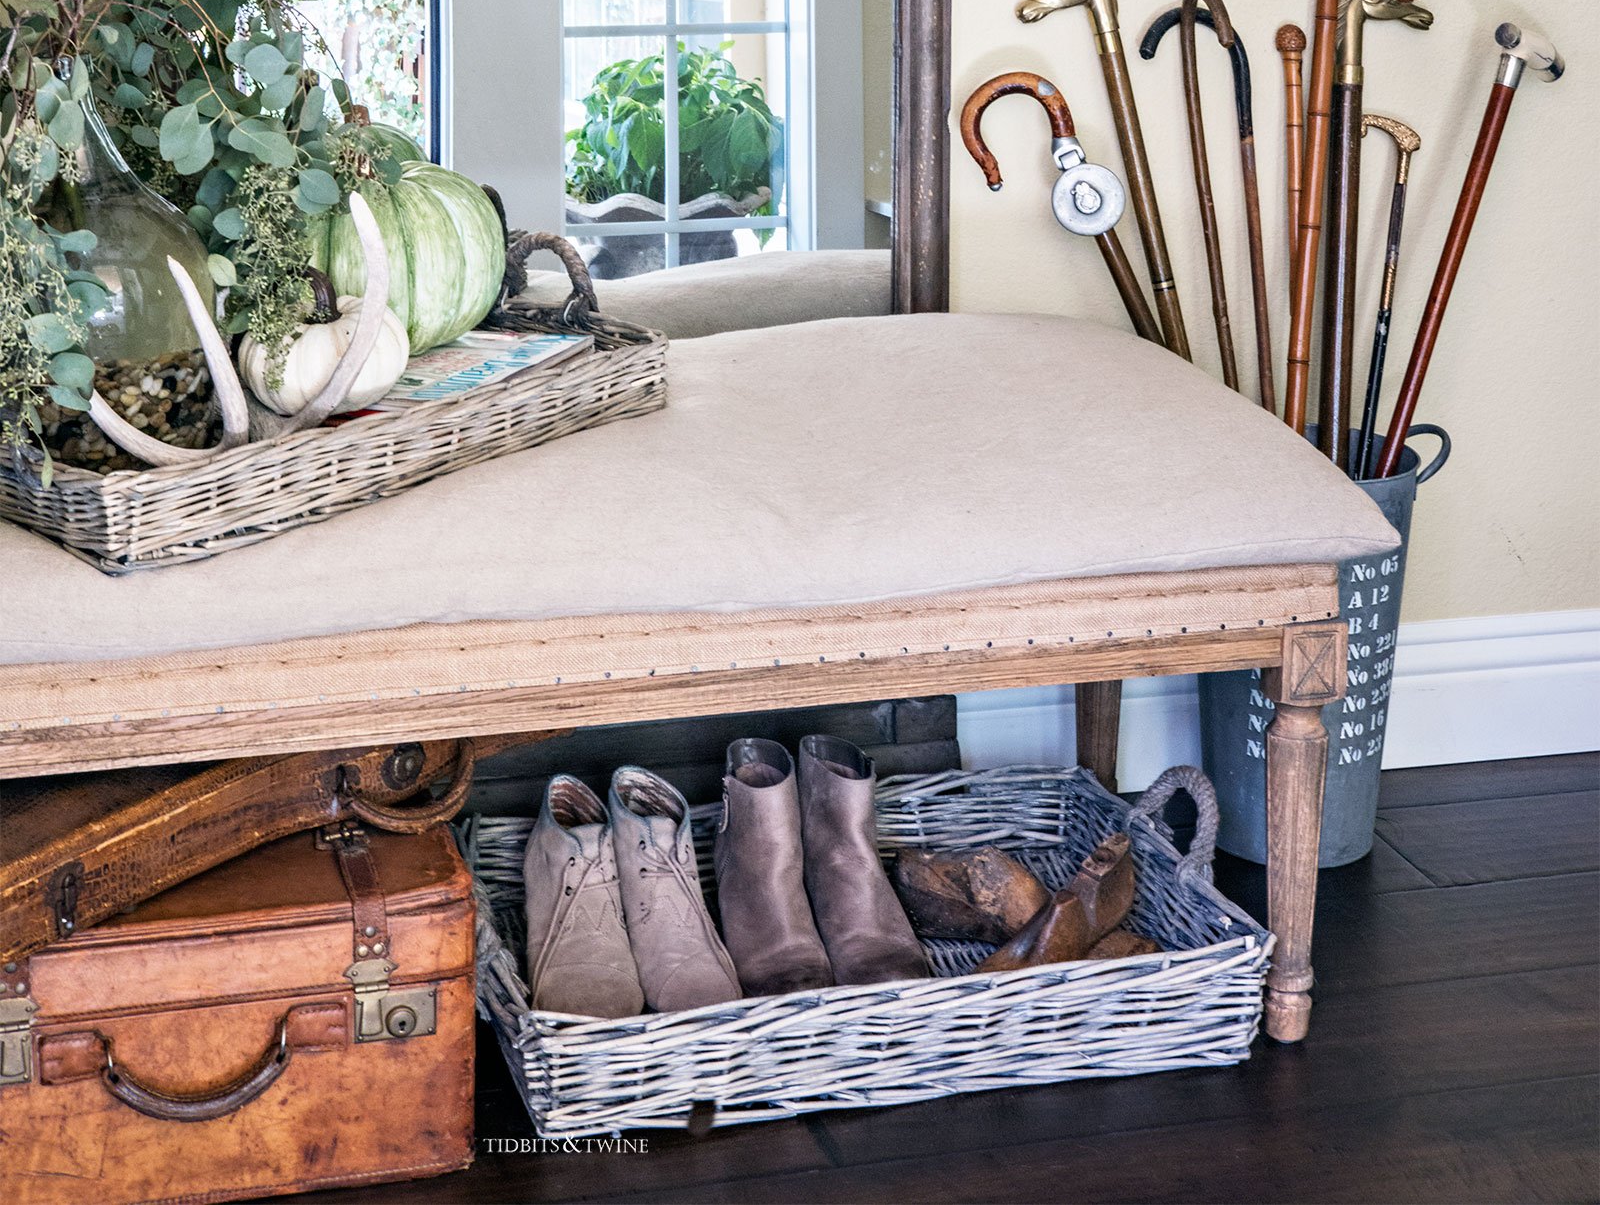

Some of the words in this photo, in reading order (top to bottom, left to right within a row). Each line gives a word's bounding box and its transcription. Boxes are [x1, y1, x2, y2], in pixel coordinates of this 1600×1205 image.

[1350, 564, 1376, 583] No
[1347, 591, 1363, 609] A
[1371, 584, 1389, 606] 12
[1348, 617, 1362, 635] B
[1368, 613, 1379, 631] 4
[1347, 642, 1370, 661] No
[1346, 665, 1368, 687] No
[1249, 689, 1275, 710] No
[1342, 694, 1366, 714] No
[1340, 721, 1364, 740] No
[1370, 709, 1385, 731] 16
[1338, 746, 1362, 765] No
